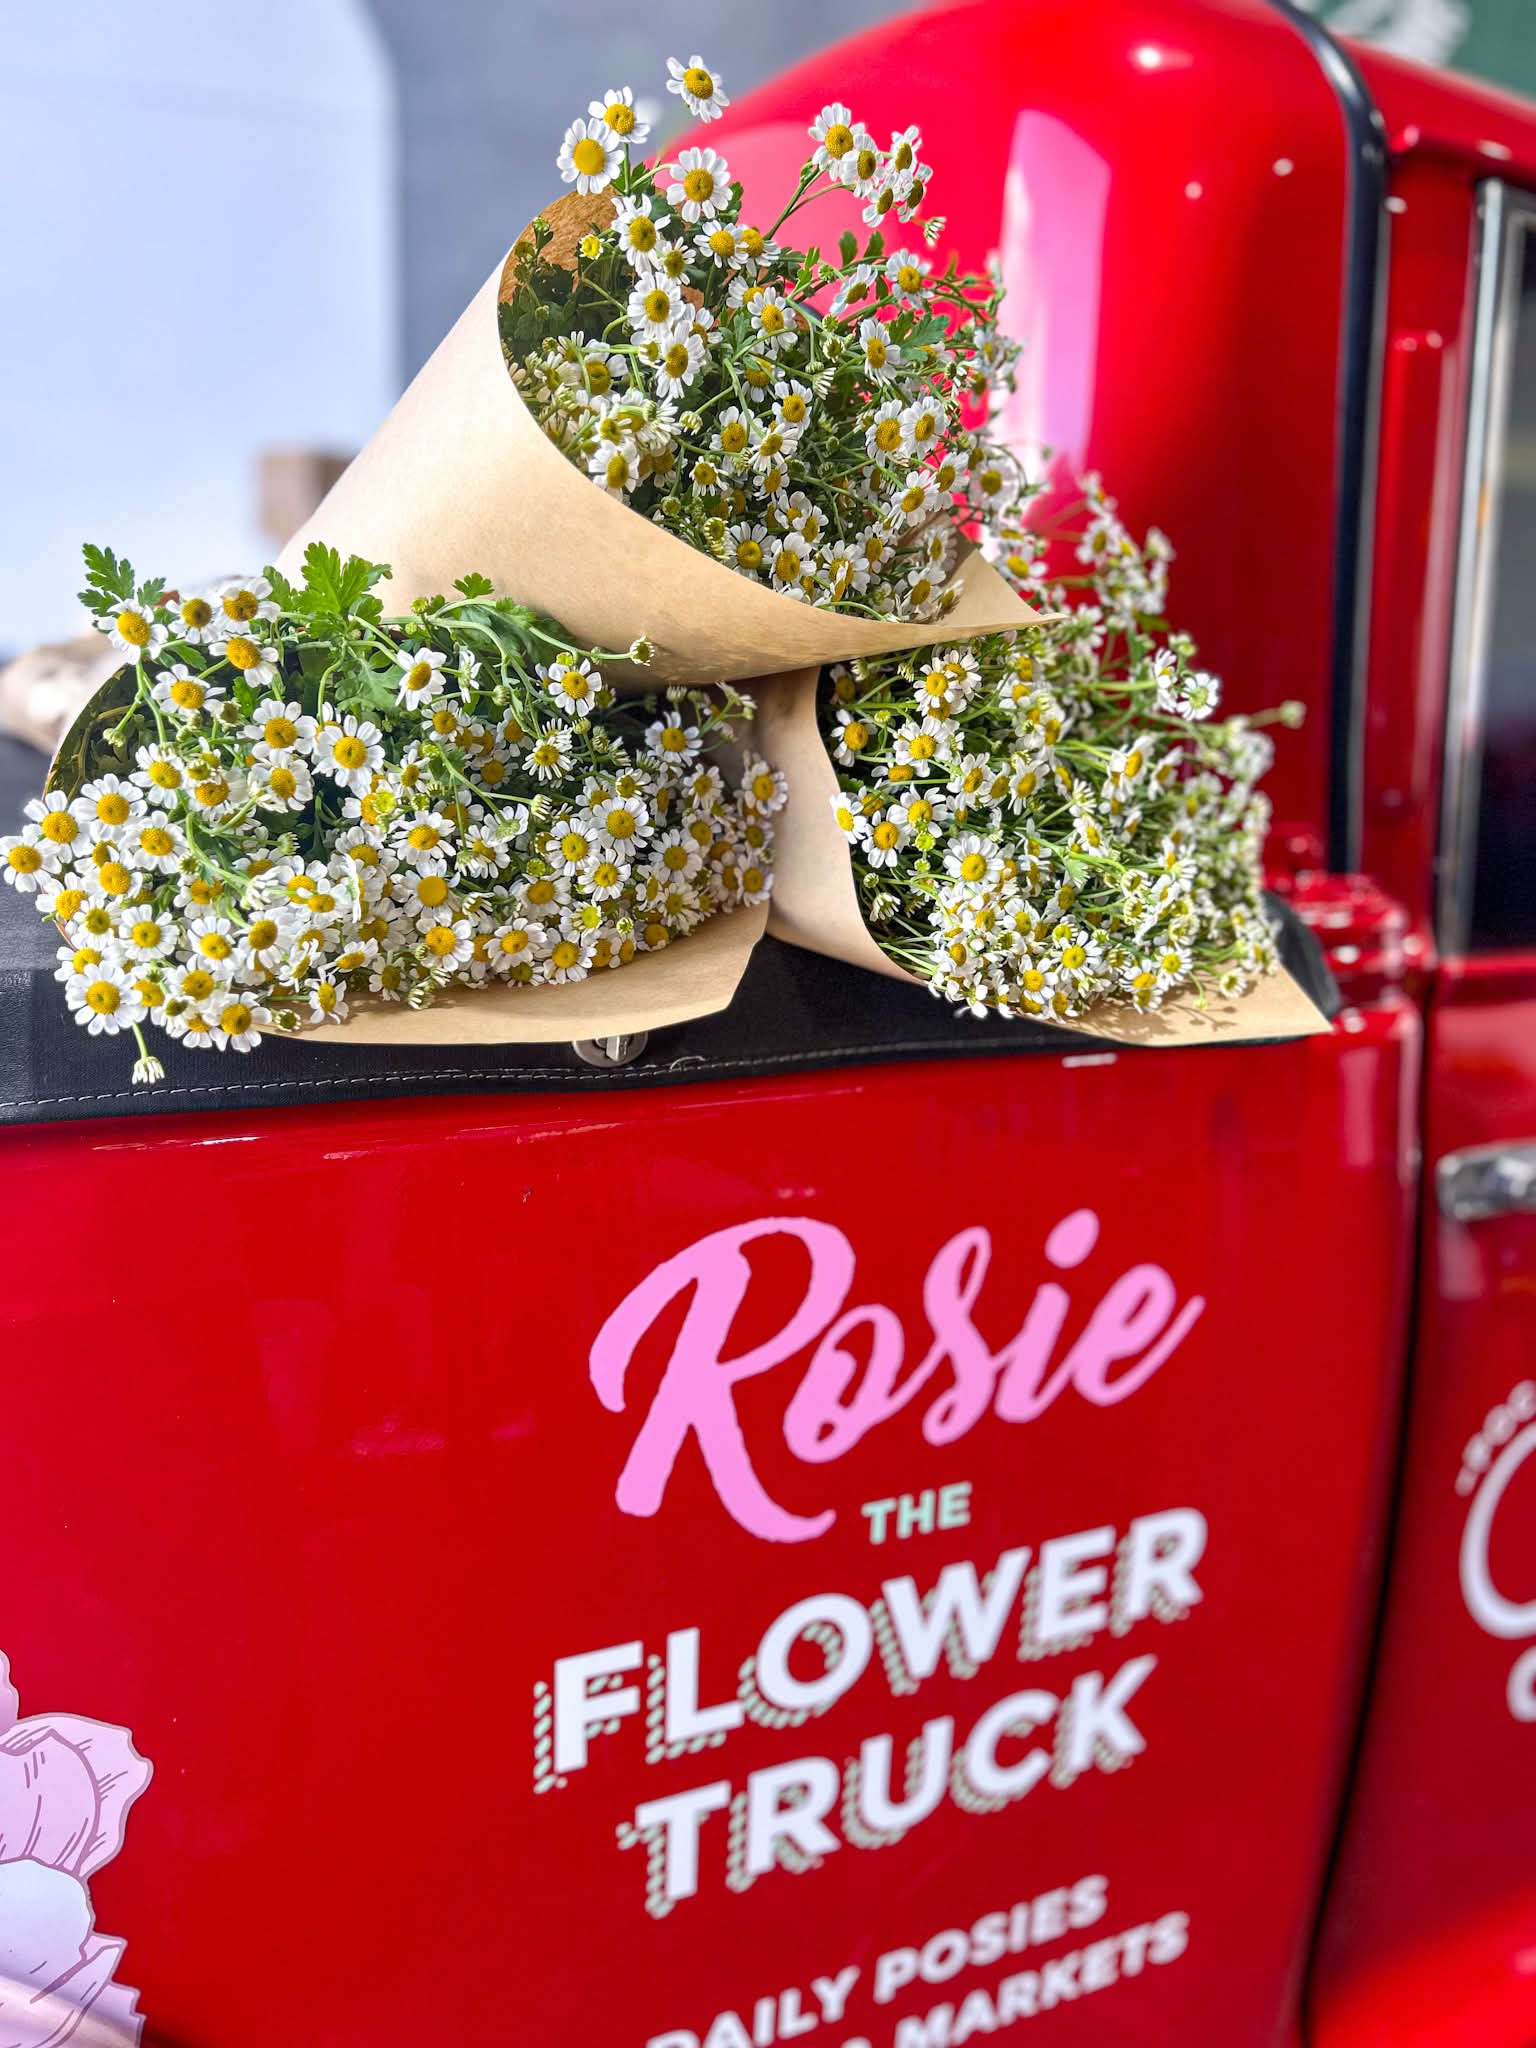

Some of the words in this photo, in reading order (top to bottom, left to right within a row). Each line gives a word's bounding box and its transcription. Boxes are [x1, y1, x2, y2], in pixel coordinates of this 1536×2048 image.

[589, 1209, 1205, 1543] Rosie
[862, 1482, 972, 1544] THE
[535, 1507, 1208, 1792] FLOWER
[616, 1654, 1157, 1918] TRUCK
[873, 1874, 1109, 2003] POSIES
[894, 1911, 1190, 2048] MARKETS
